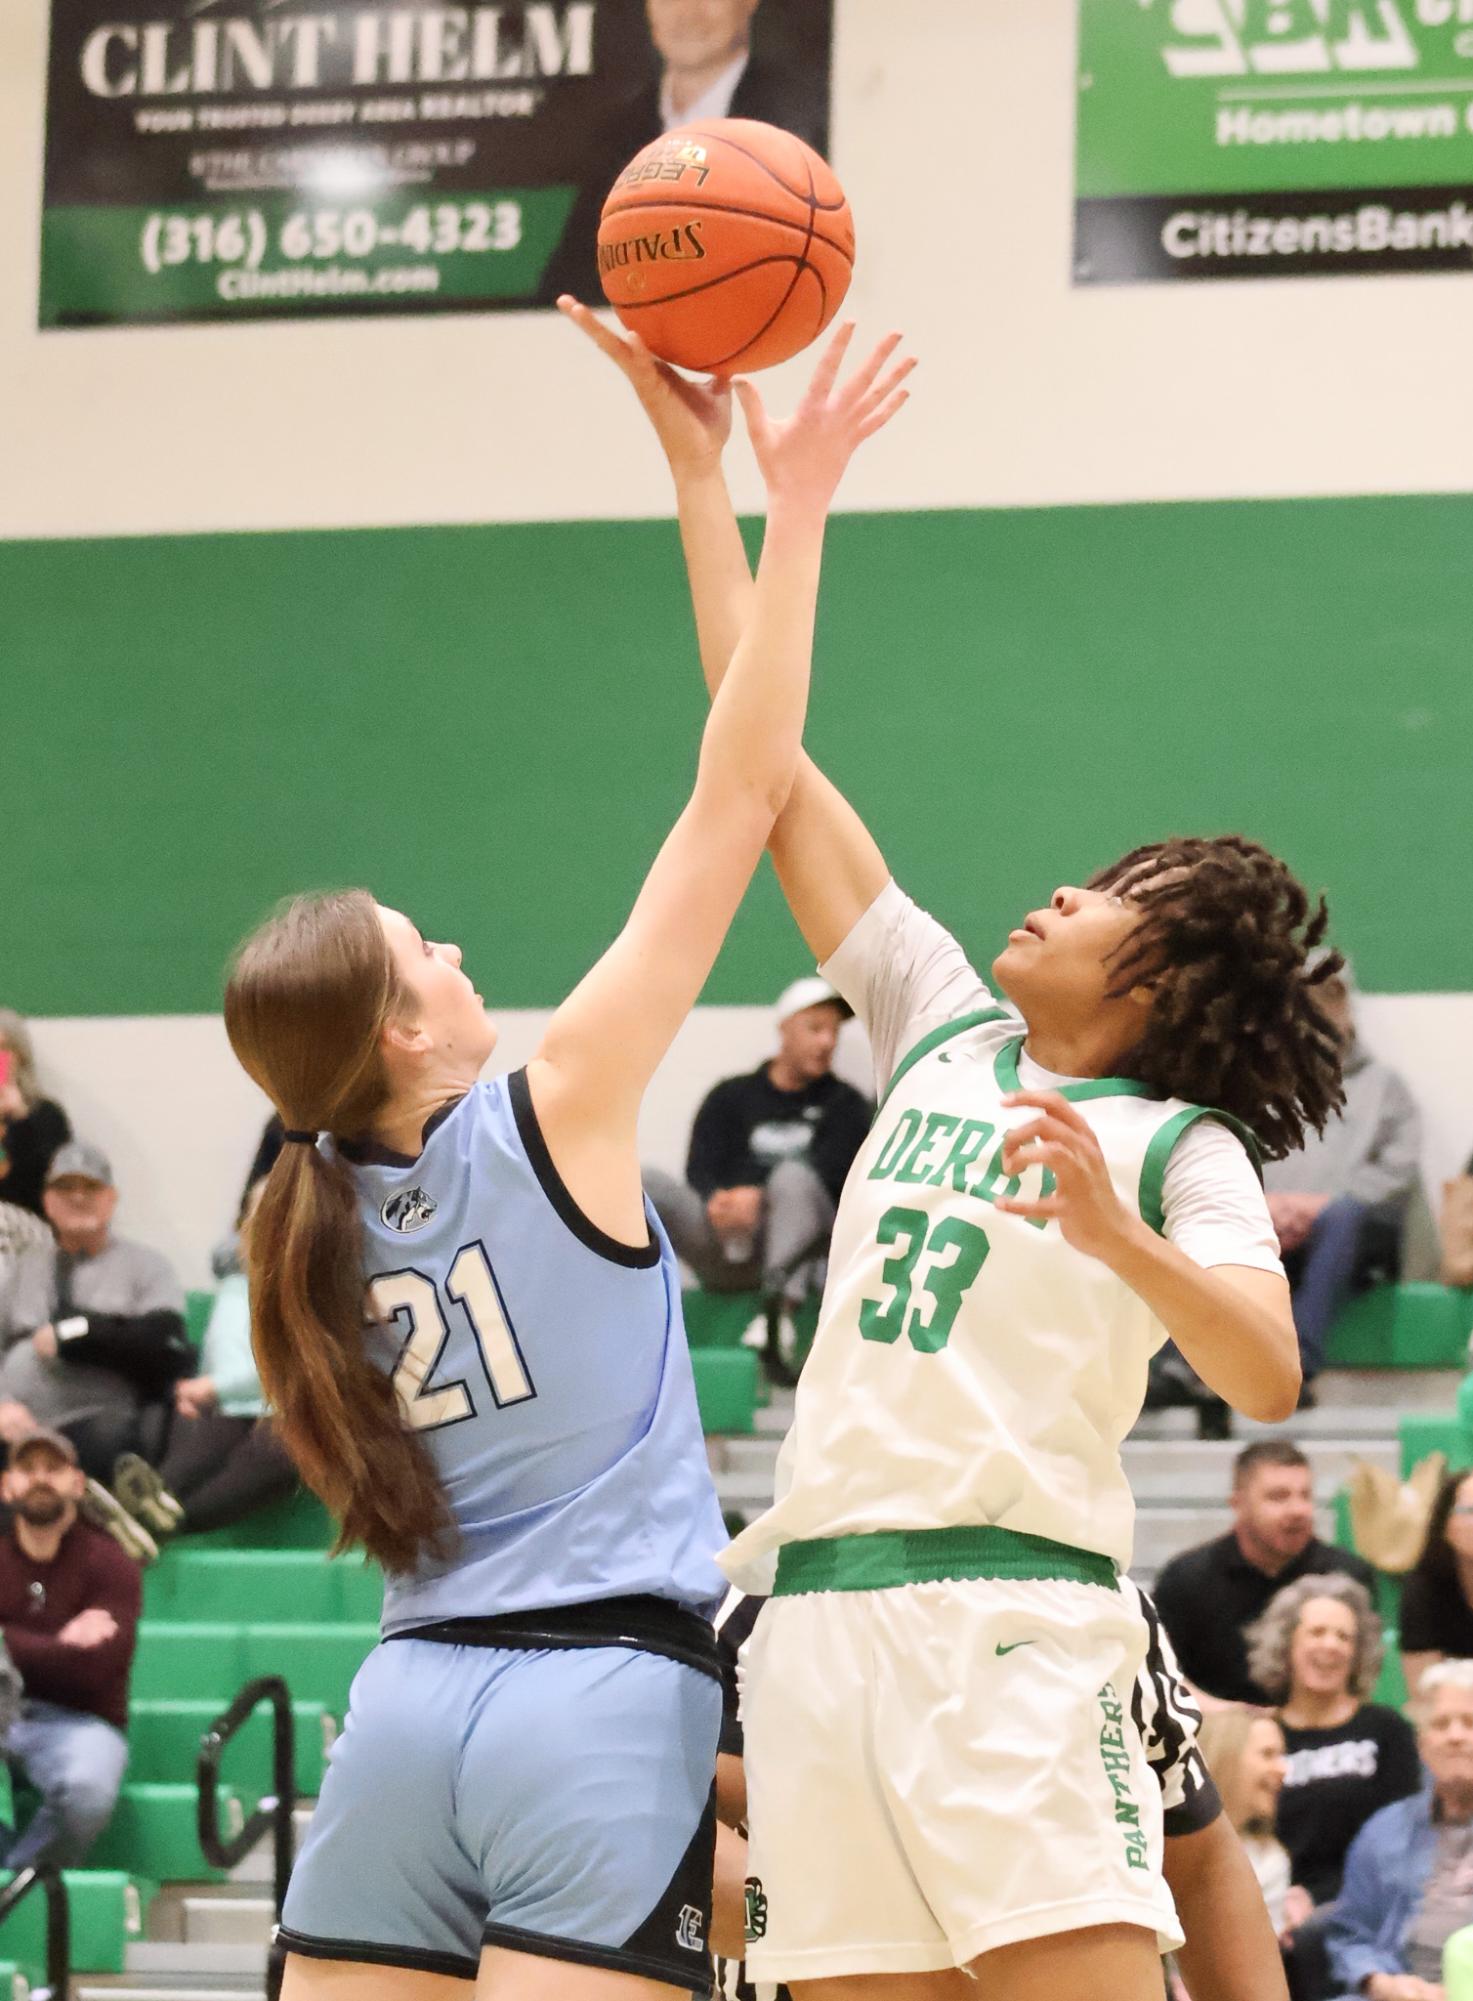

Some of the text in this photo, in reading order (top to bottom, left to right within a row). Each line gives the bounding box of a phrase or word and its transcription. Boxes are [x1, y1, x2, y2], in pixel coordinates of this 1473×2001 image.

[81, 3, 597, 98] CLINT HELM
[1215, 104, 1457, 146] Hometown
[140, 201, 522, 273] (316) 650-4323
[599, 221, 706, 272] SPALDIN
[217, 266, 440, 300] ClintHelm.com
[858, 1205, 991, 1354] 33
[365, 1238, 538, 1432] 21
[1097, 1681, 1150, 1871] PANTHERS
